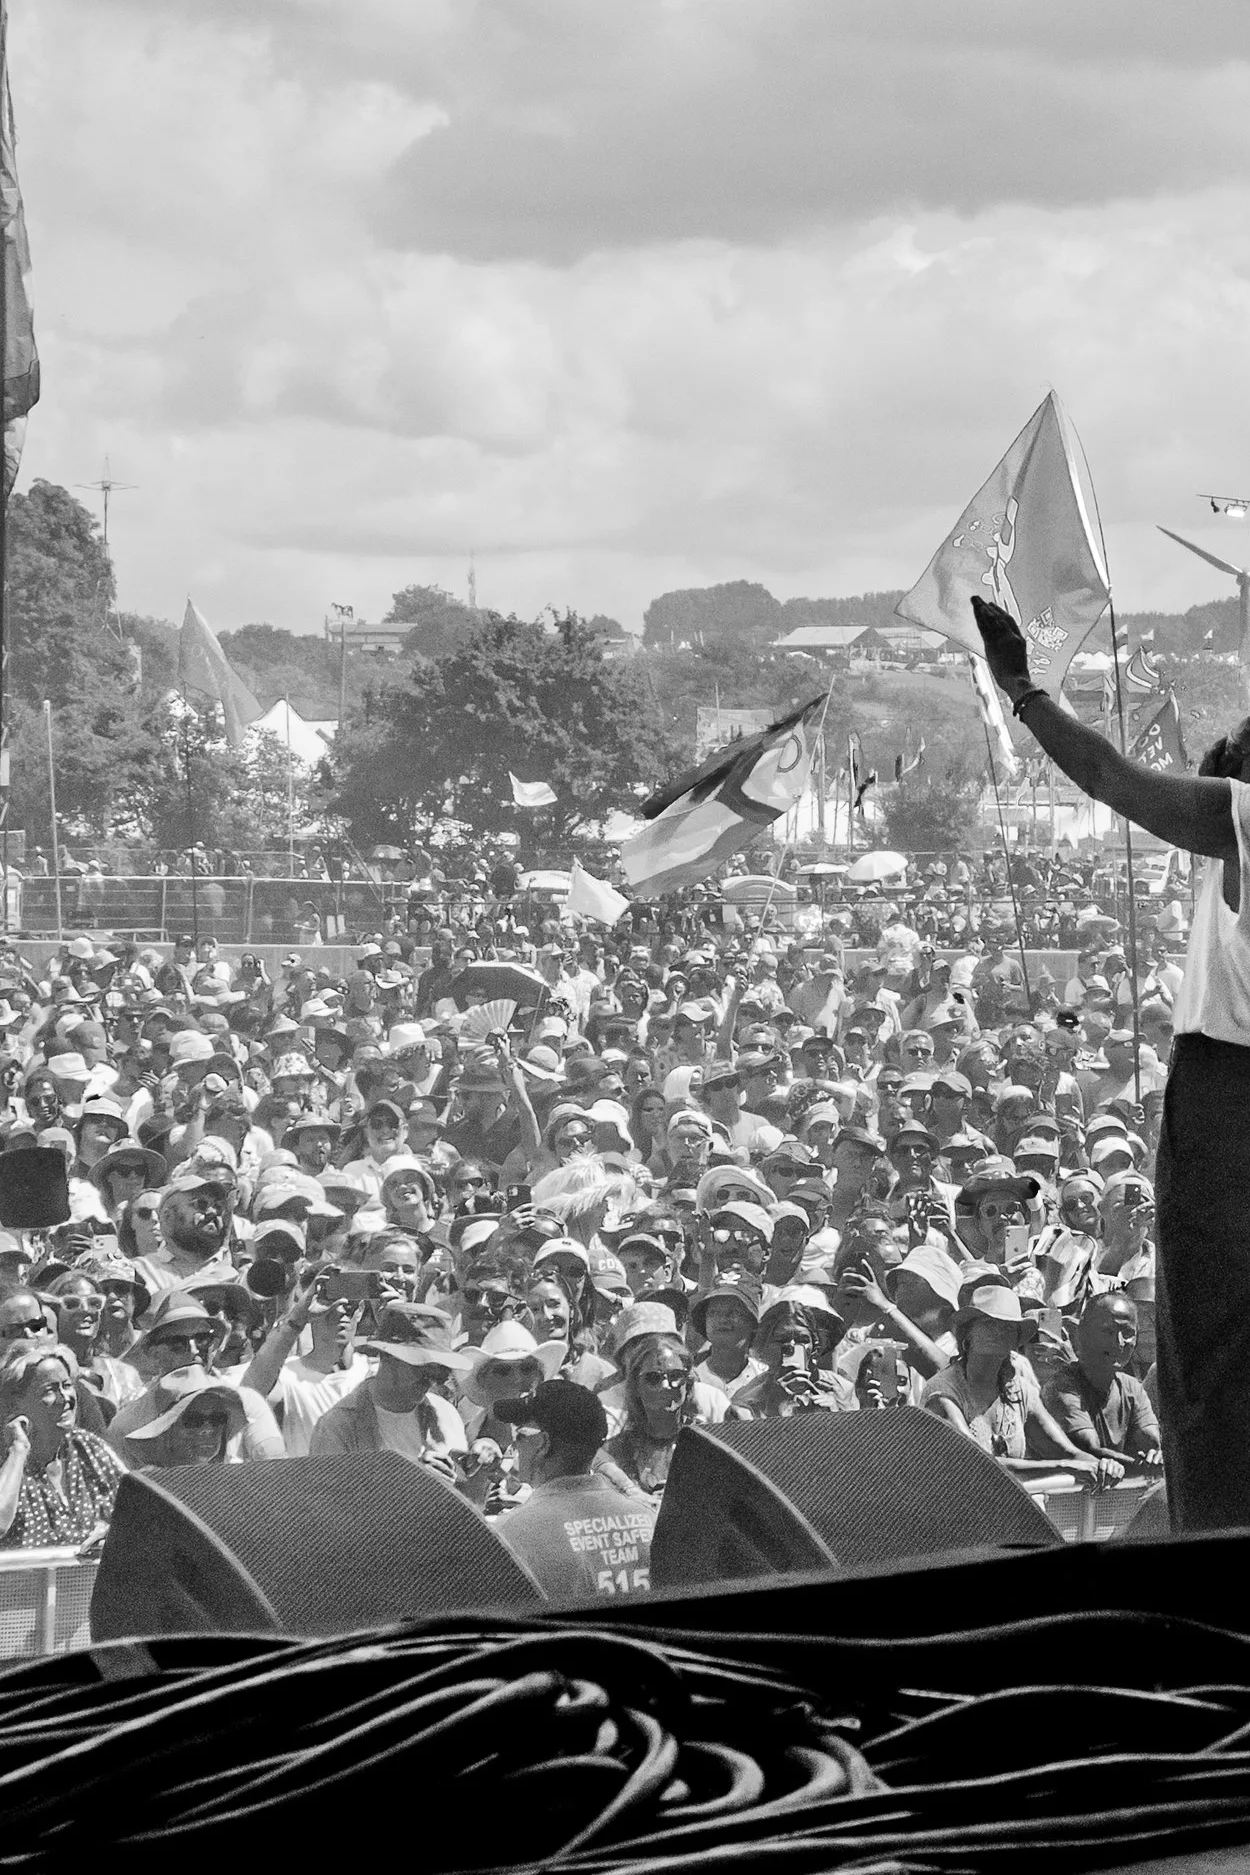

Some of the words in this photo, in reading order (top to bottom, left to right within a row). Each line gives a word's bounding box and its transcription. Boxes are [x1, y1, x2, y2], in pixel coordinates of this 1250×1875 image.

[563, 1514, 654, 1536] SPECIALIZED
[569, 1534, 611, 1552] EVENT
[612, 1528, 653, 1548] SAFE
[600, 1547, 638, 1565] TEAM
[597, 1568, 650, 1595] 515
